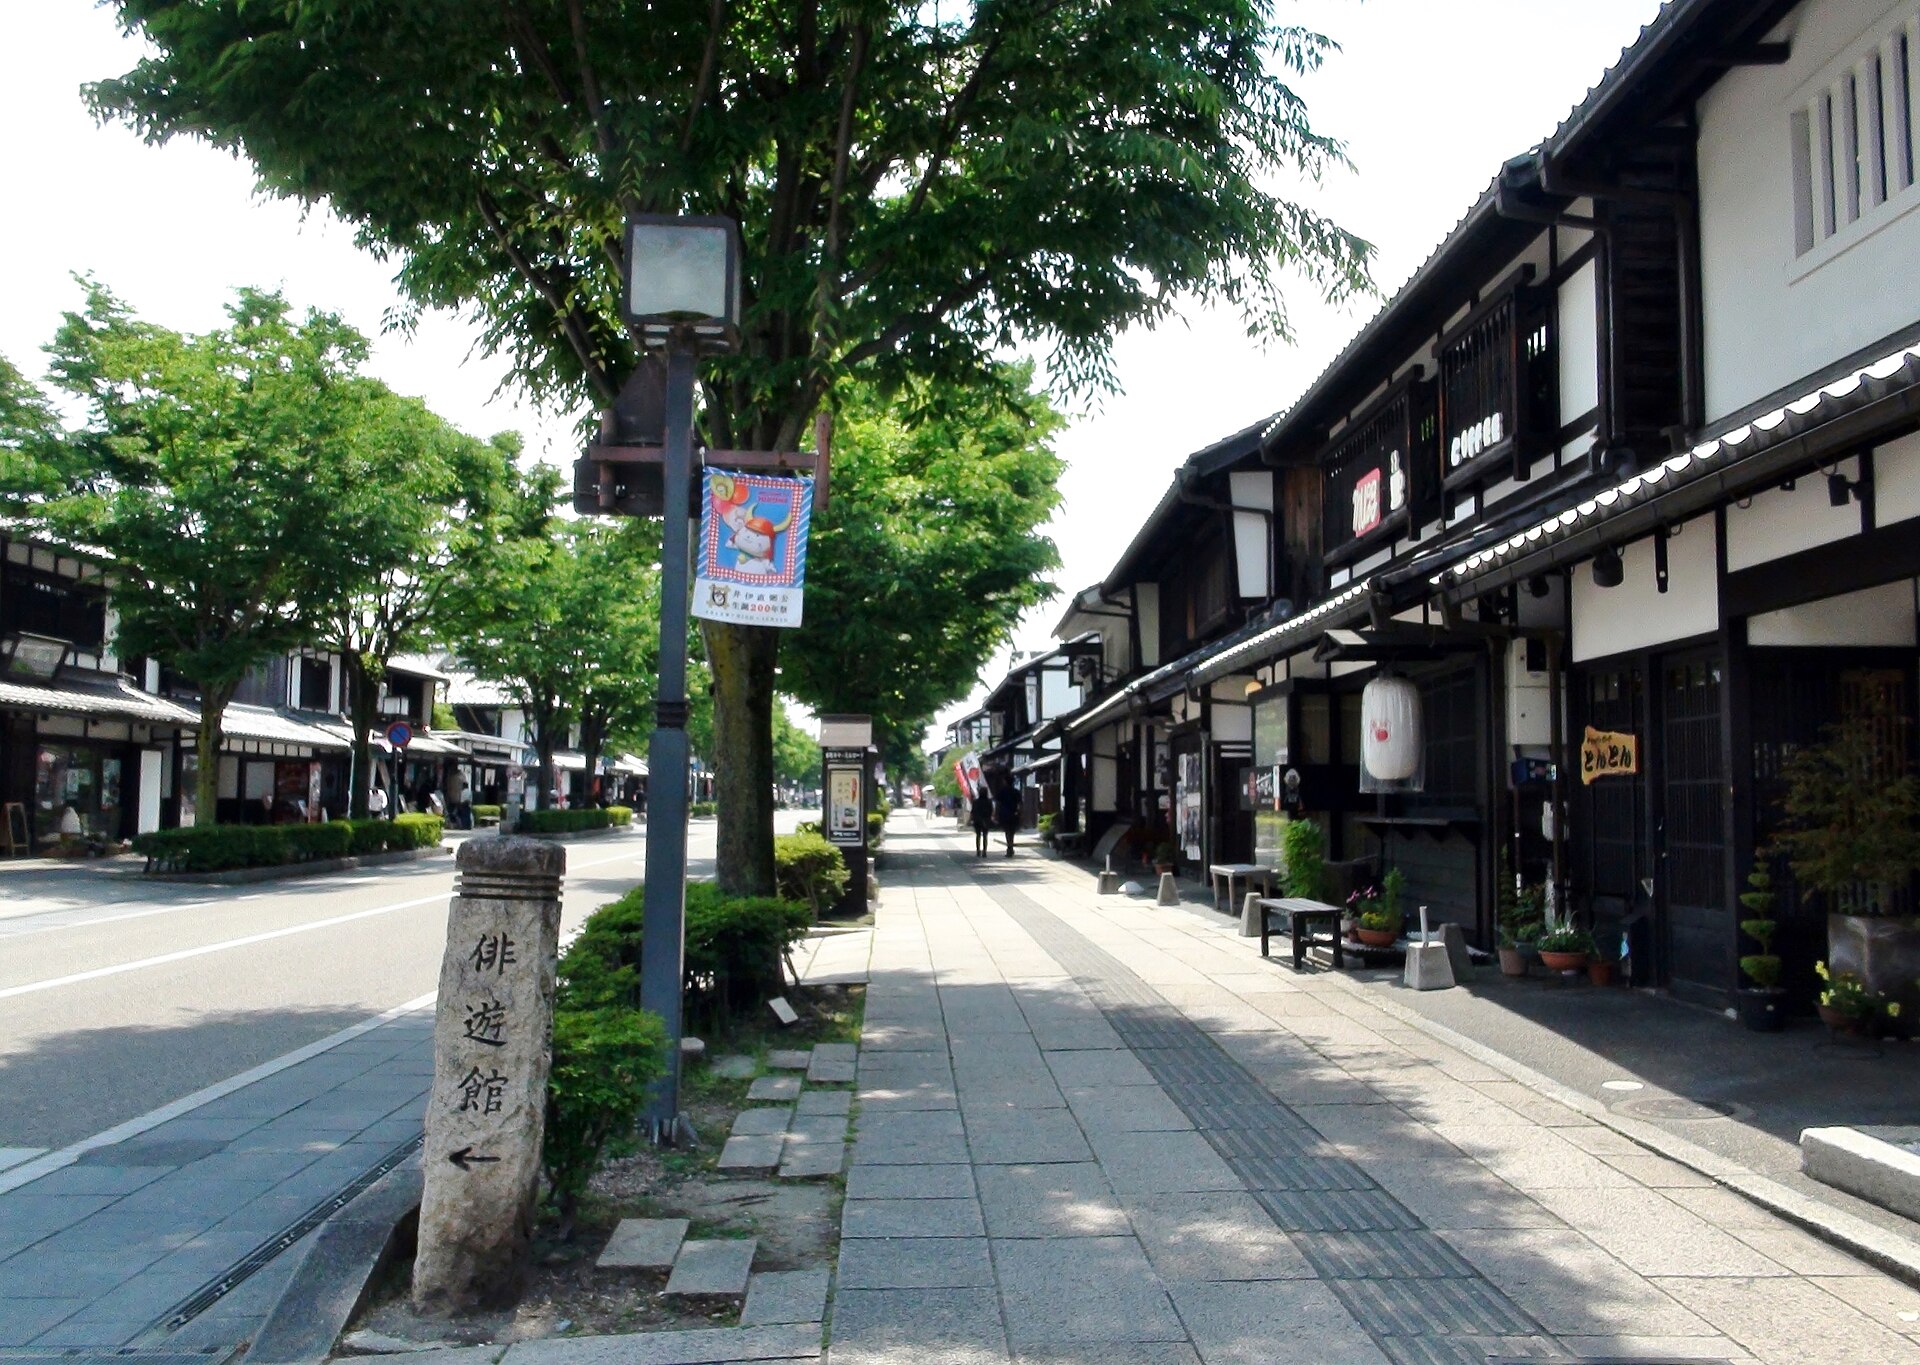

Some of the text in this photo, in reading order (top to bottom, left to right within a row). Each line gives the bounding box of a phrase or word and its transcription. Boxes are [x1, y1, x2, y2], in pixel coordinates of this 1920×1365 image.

[1451, 412, 1503, 466] COFFEE
[458, 931, 517, 1117] 俳遊館
